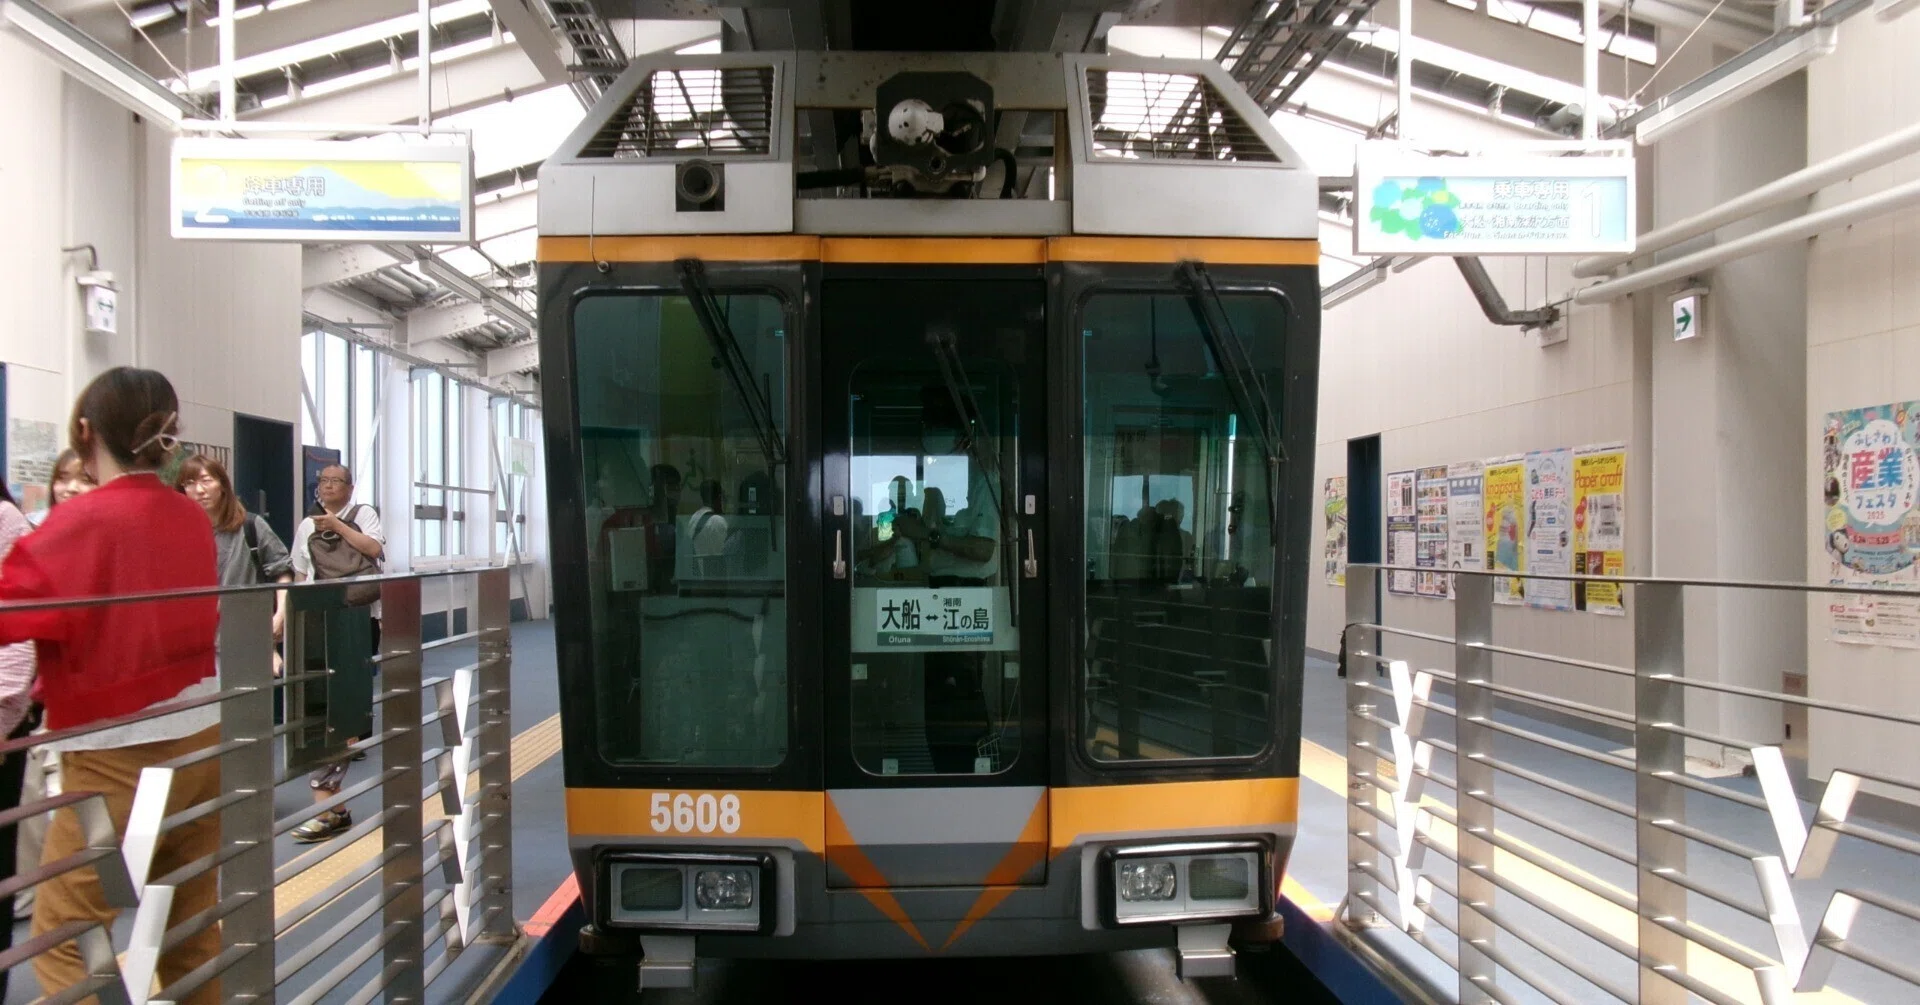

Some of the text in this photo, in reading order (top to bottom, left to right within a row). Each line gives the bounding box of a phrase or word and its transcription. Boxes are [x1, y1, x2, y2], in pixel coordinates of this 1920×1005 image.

[194, 163, 230, 224] 2
[1493, 180, 1570, 200] 乗車専用
[1580, 181, 1602, 239] 1
[1854, 431, 1891, 447] ふじさわ
[1575, 464, 1623, 493] Paper craft
[1851, 447, 1903, 489] 産業
[1855, 492, 1897, 509] フェスタ
[1867, 510, 1885, 520] 2025
[881, 599, 921, 630] 大船
[943, 597, 962, 607] 湘南
[943, 607, 989, 630] 江の島
[650, 793, 741, 834] 5608
